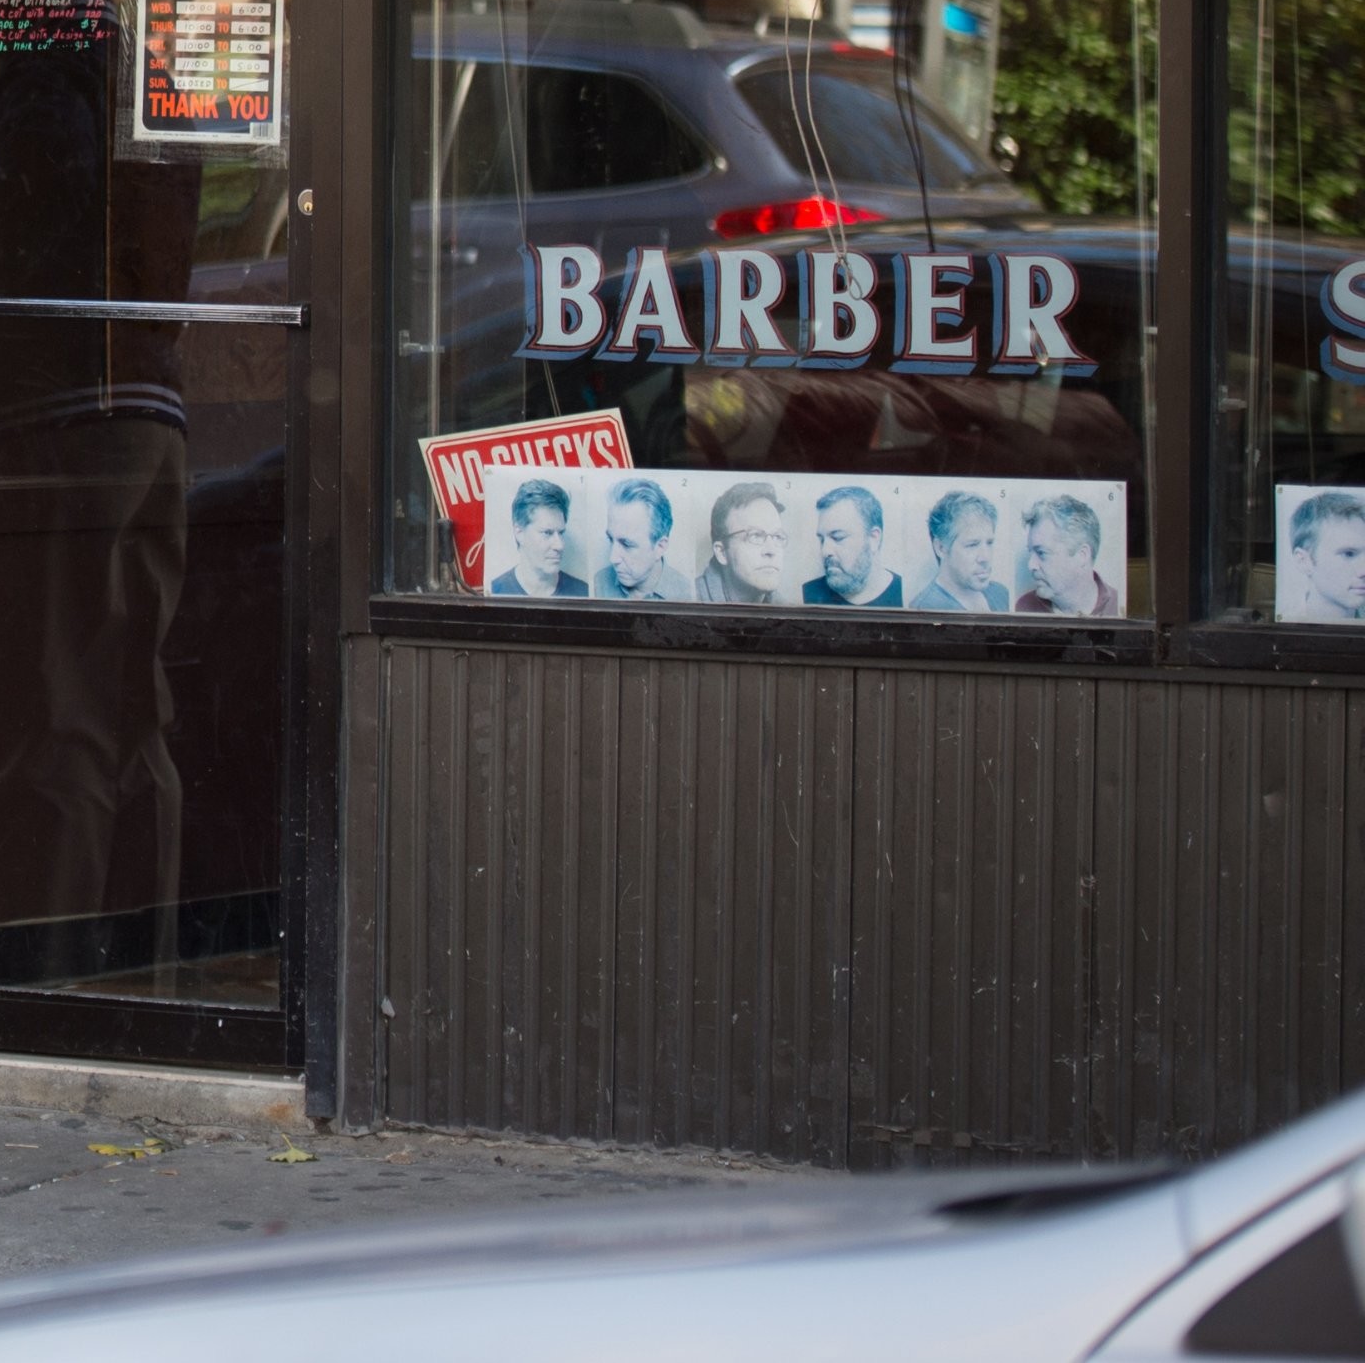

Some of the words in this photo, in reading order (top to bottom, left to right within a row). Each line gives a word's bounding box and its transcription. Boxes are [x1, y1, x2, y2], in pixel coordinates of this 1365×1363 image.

[219, 3, 230, 14] TO
[218, 22, 230, 33] TO
[217, 41, 229, 52] TO
[217, 59, 229, 70] TO
[216, 78, 228, 90] TO
[148, 93, 219, 119] THANK
[227, 94, 269, 121] YOU
[513, 241, 1100, 378] BARBER
[438, 449, 486, 506] NO
[1107, 491, 1115, 501] 6
